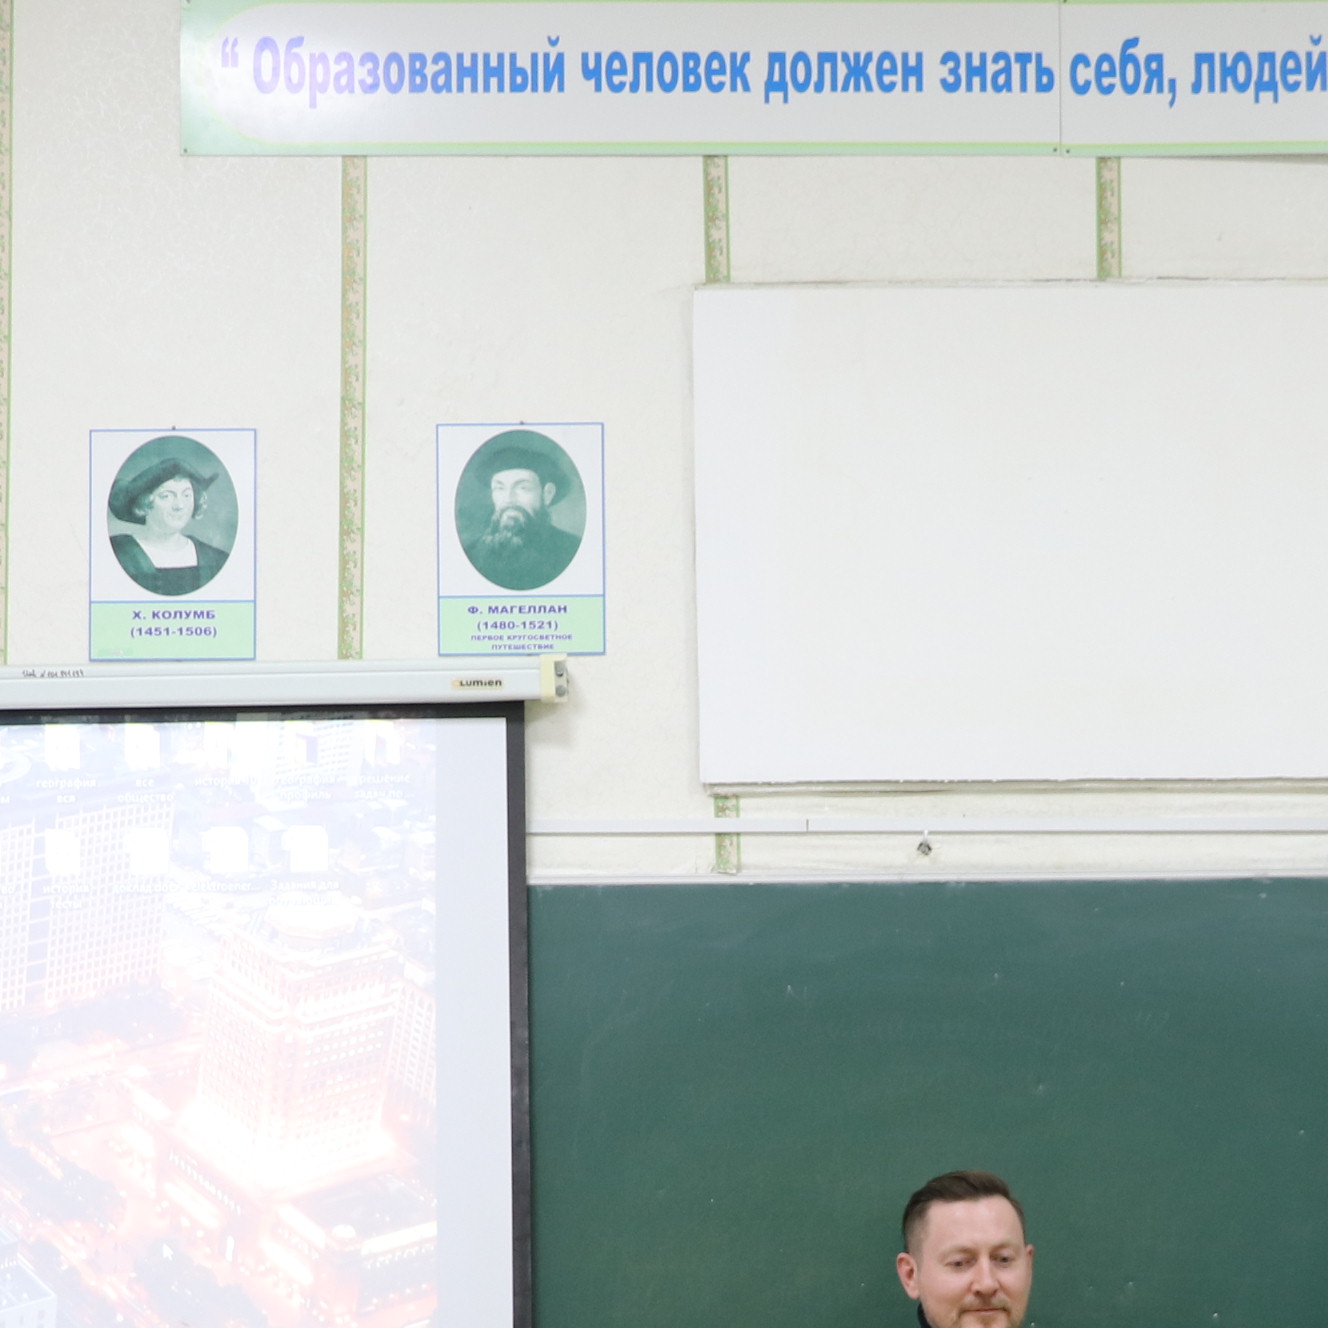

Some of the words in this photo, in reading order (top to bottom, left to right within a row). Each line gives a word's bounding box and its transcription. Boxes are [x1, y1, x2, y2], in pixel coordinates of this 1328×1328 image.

[581, 49, 751, 94] человек
[764, 48, 924, 104] должен
[939, 48, 1054, 94] знать
[1068, 38, 1177, 108] себя,
[1191, 35, 1328, 103] людей
[152, 610, 216, 620] КОЛУМБ
[488, 605, 568, 614] МАГЕЛЛАН
[477, 620, 558, 632] (1480-1521)
[130, 627, 217, 638] (1451-1506)
